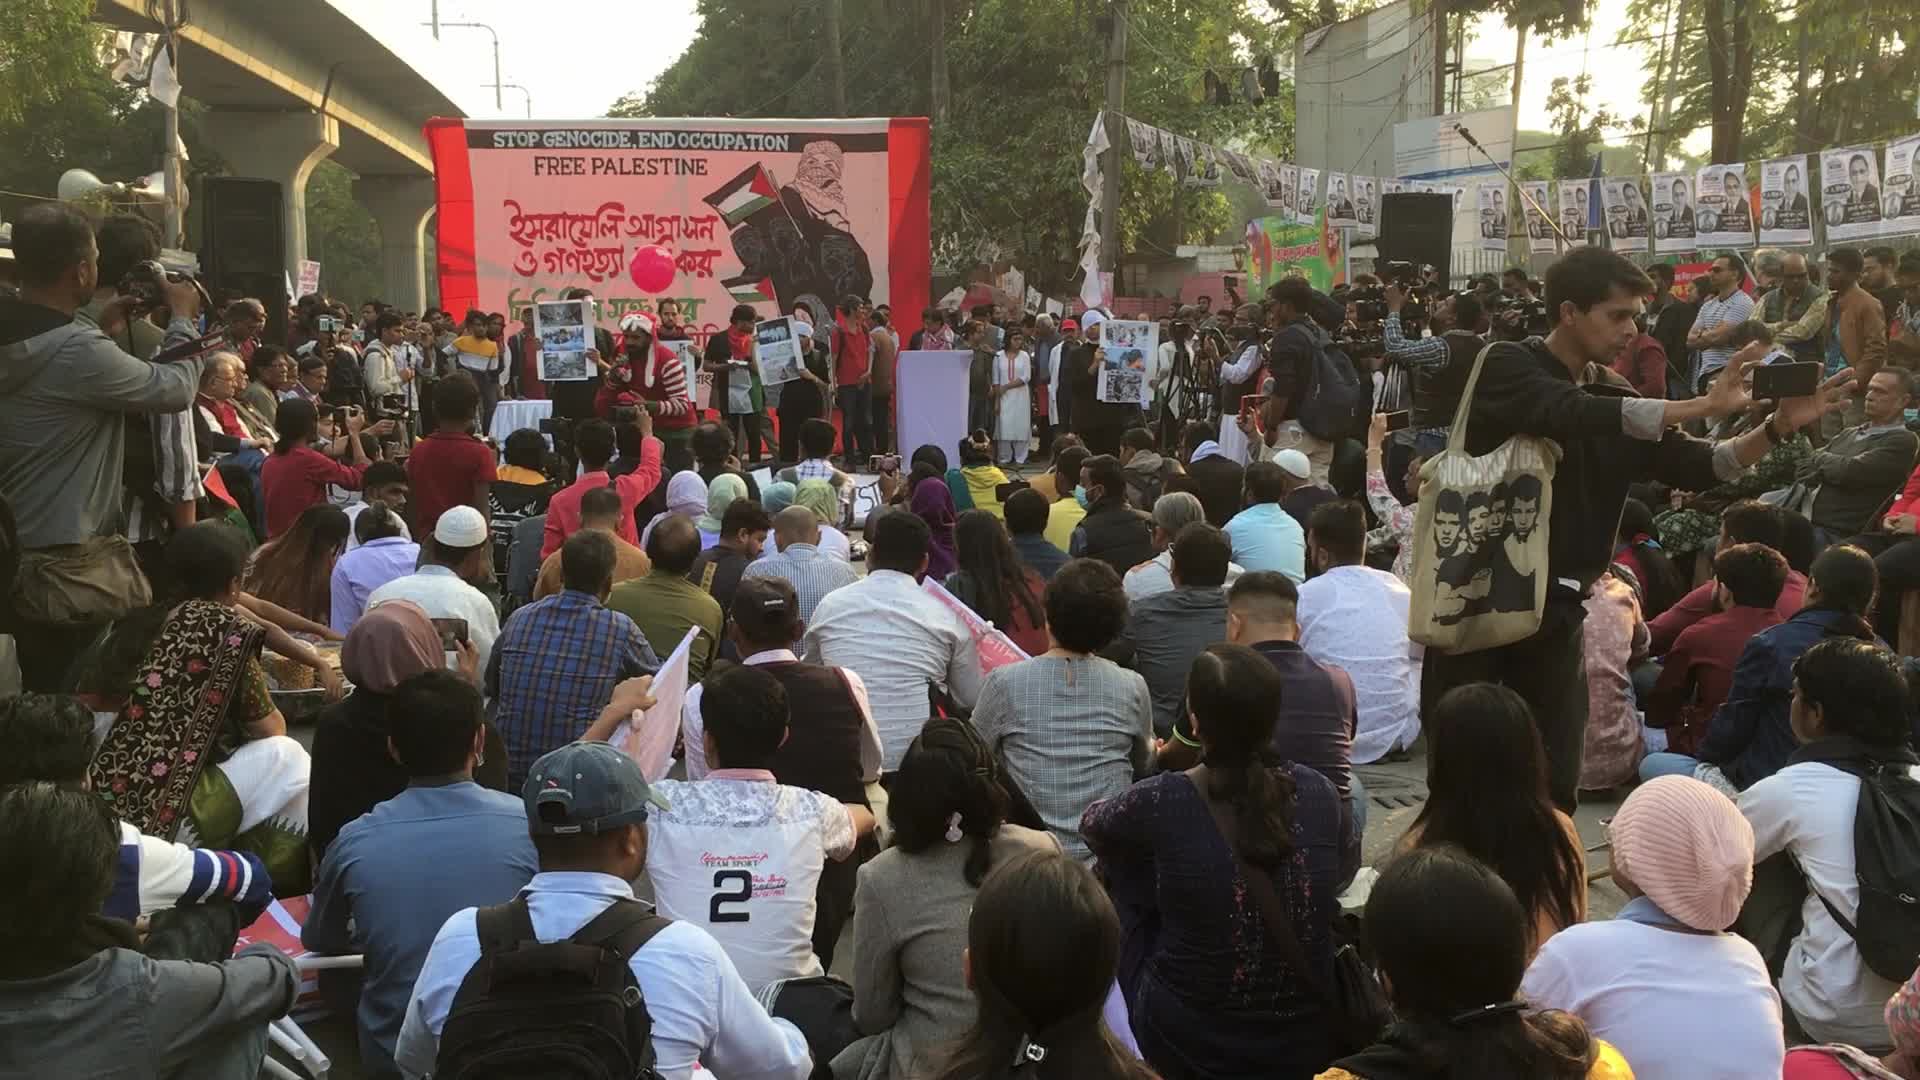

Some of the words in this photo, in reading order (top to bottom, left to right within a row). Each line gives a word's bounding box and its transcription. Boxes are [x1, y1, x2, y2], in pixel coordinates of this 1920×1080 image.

[493, 131, 540, 148] STOP
[638, 132, 676, 148] END
[677, 132, 790, 151] OCCUPATION
[534, 156, 587, 176] FREE
[591, 157, 708, 176] PALESTINE
[514, 251, 538, 277] ও
[710, 869, 752, 922] 2
